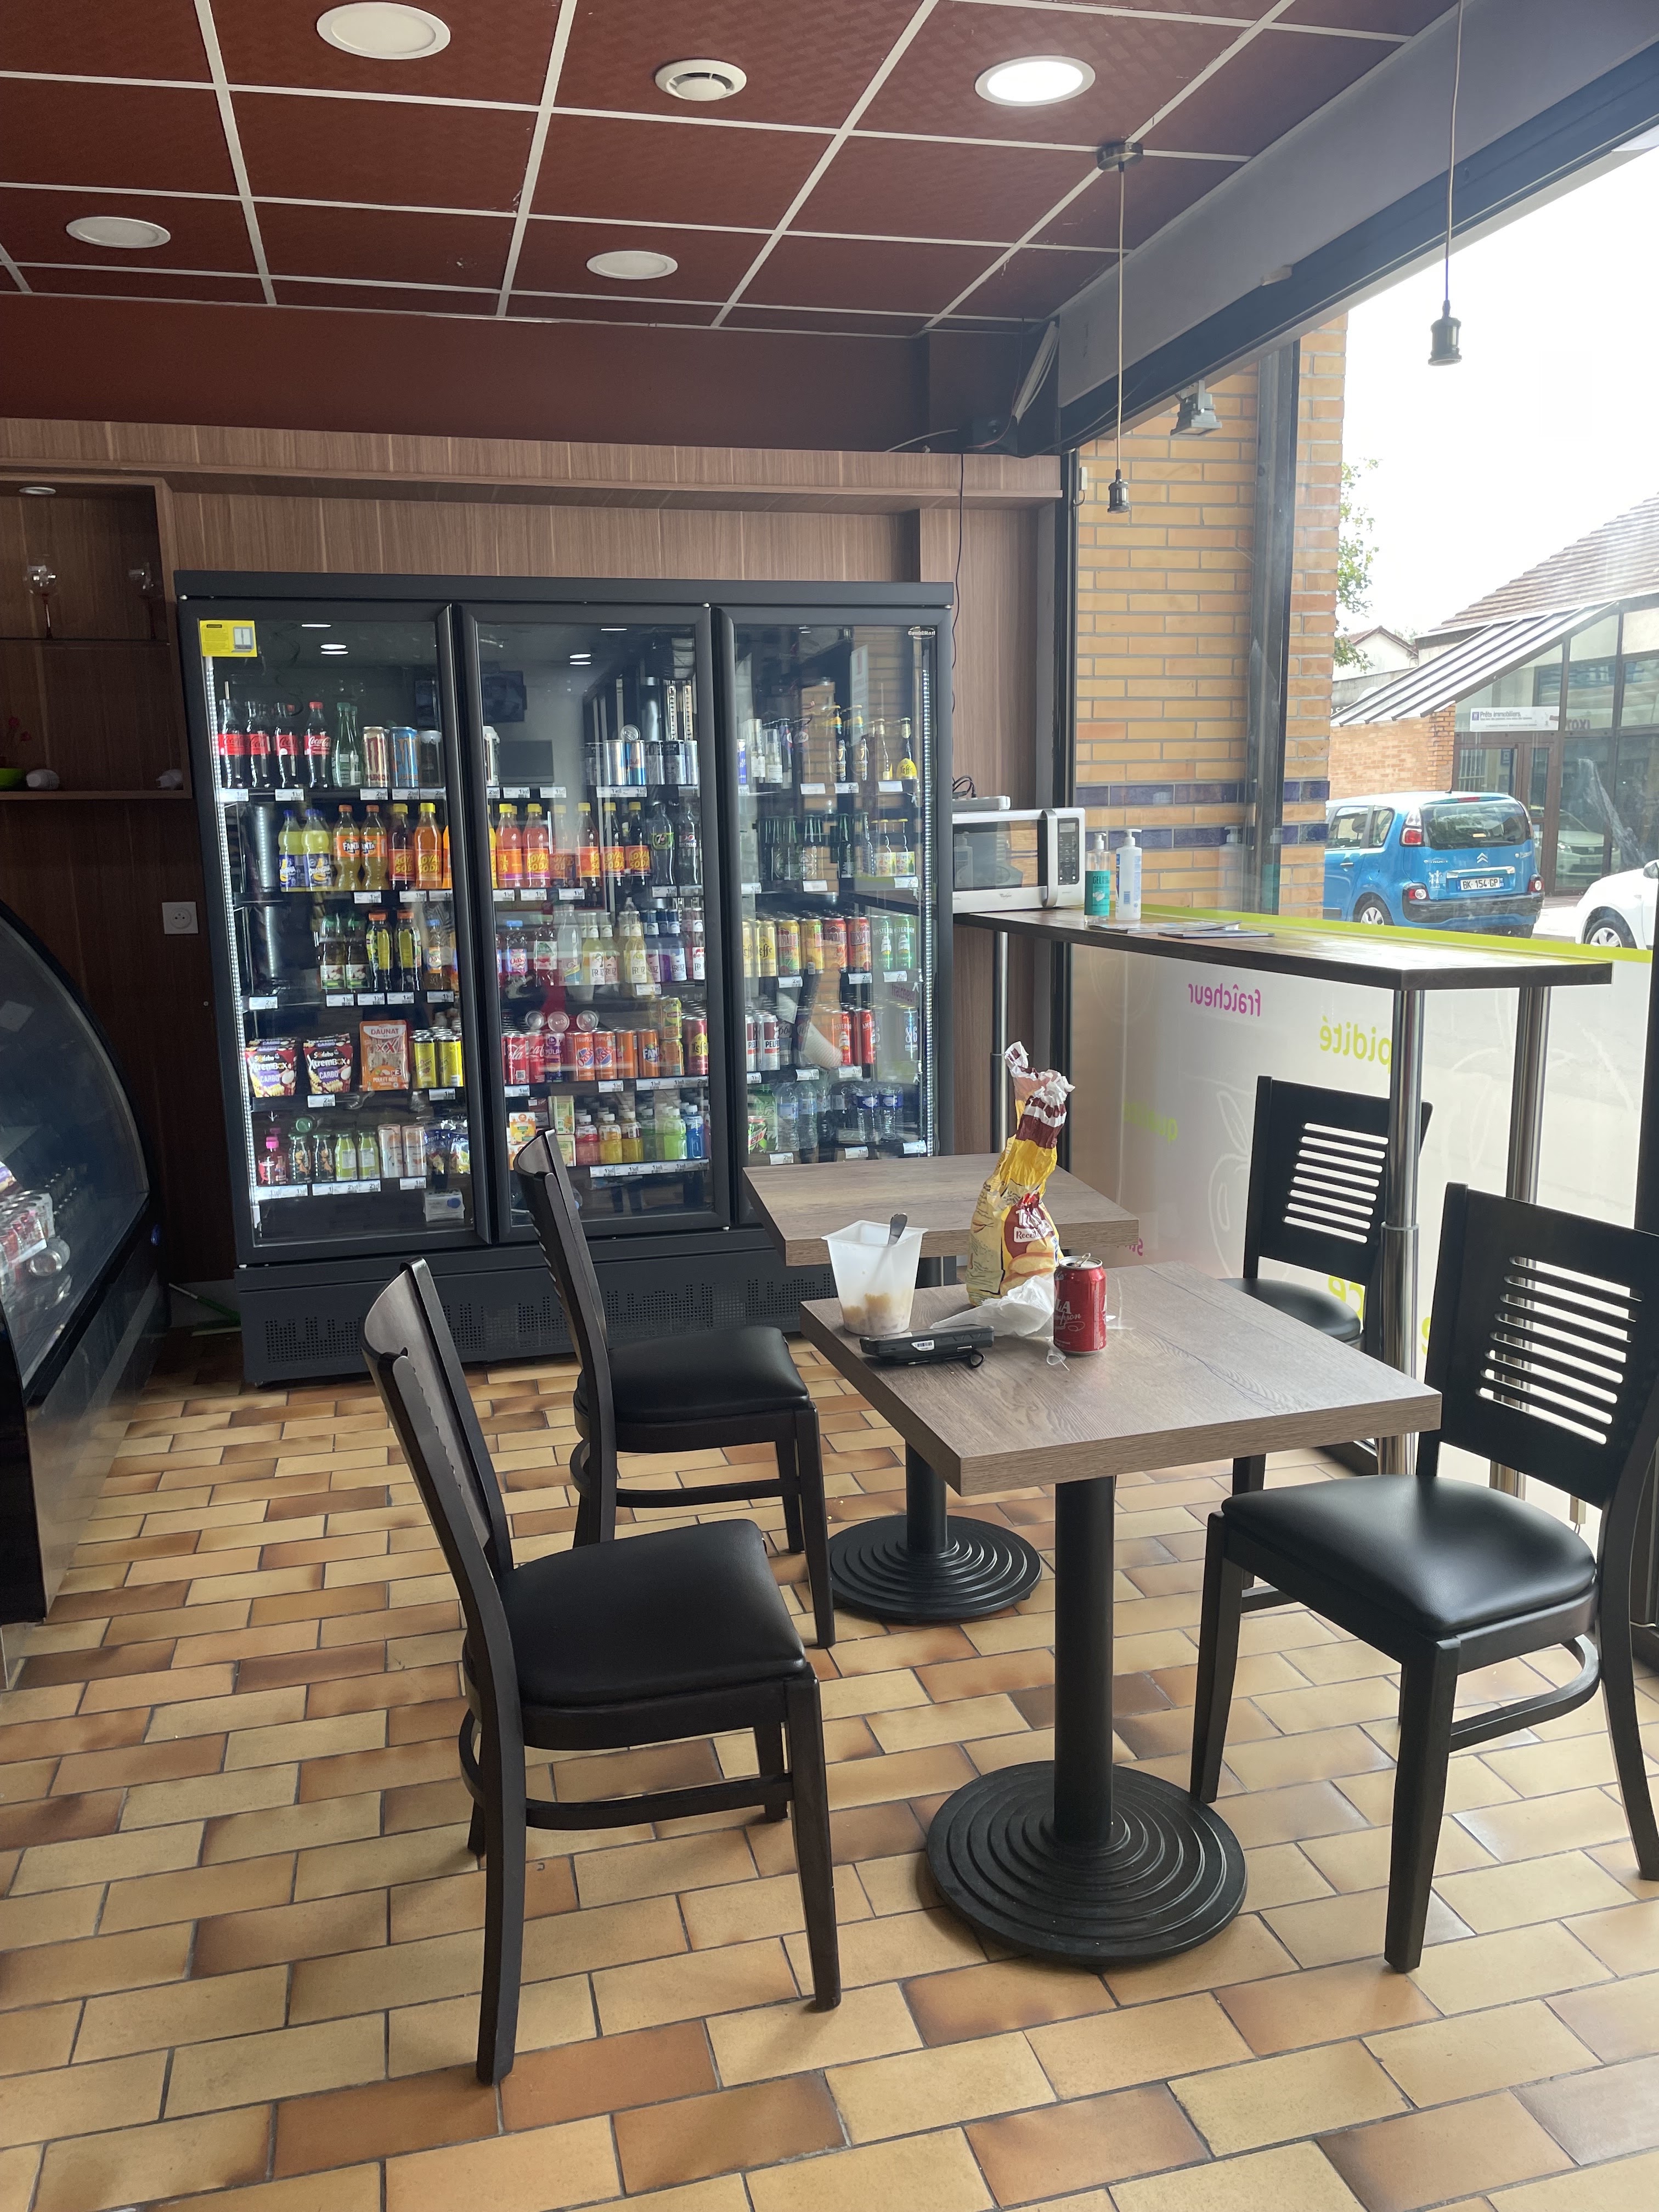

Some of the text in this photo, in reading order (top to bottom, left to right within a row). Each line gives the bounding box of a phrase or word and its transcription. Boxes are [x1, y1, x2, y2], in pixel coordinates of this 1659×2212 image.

[1475, 880, 1487, 888] 154
[319, 1070, 339, 1079] CARBO
[260, 1075, 280, 1083] CARBO
